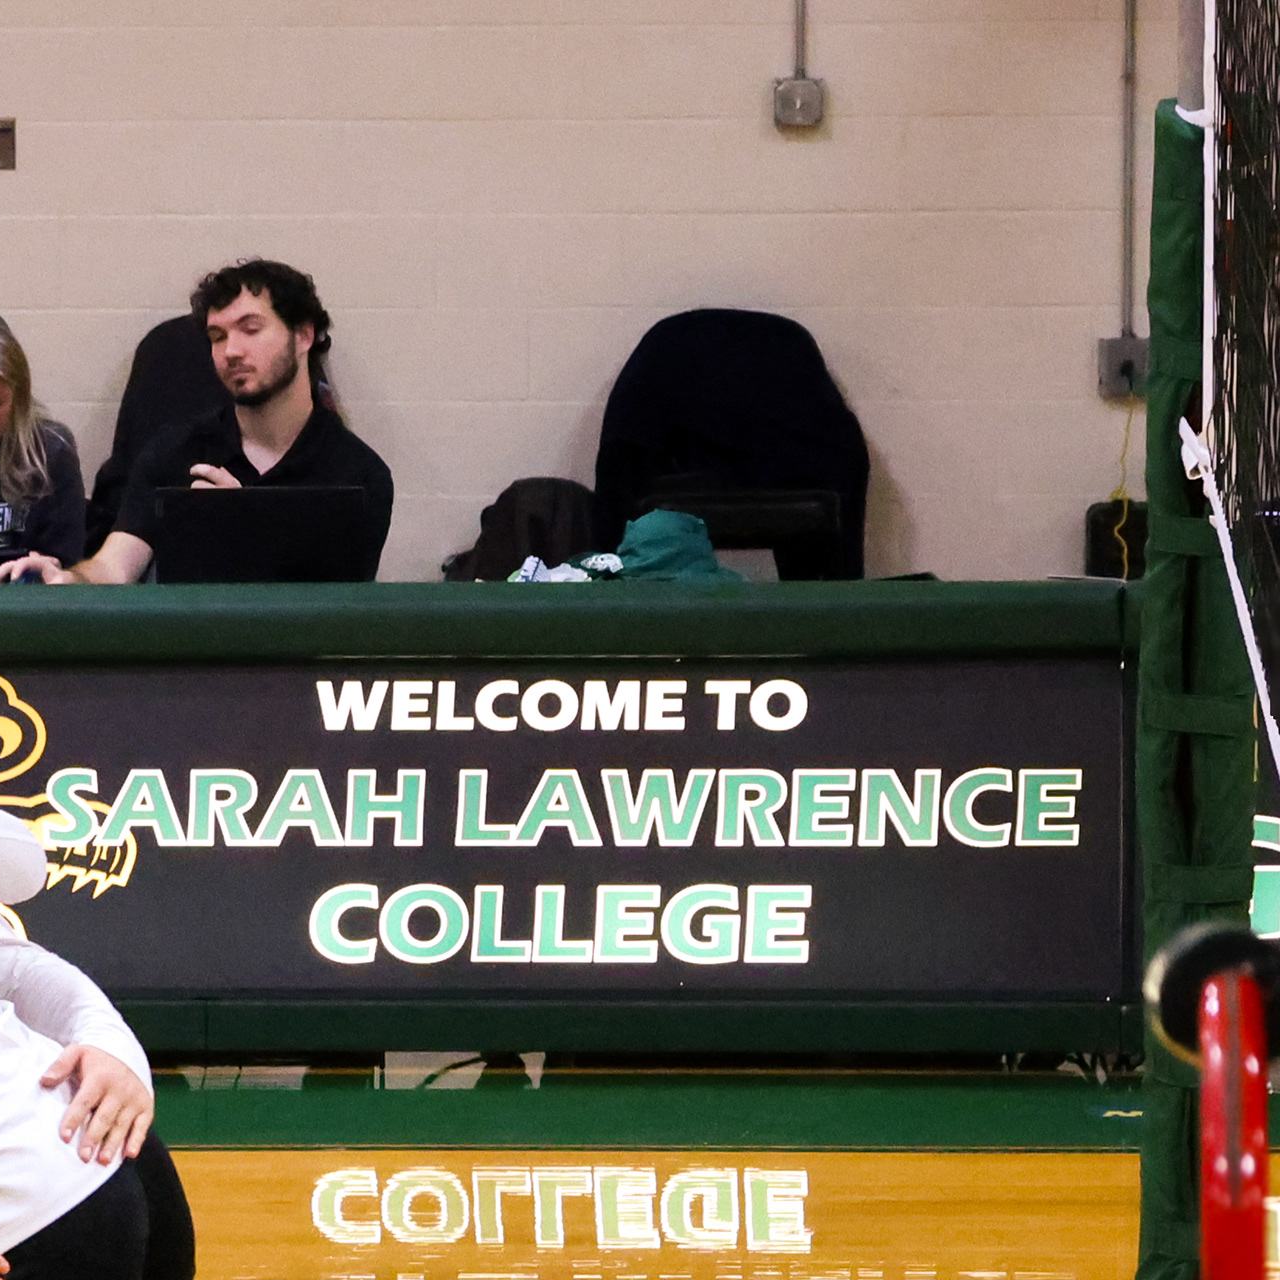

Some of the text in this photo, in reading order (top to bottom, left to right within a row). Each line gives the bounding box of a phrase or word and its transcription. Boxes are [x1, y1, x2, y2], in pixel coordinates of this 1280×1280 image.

[316, 679, 809, 731] WELCOME TO
[40, 766, 1083, 848] SARAH LAWRENCE
[308, 883, 813, 964] COLLEGE
